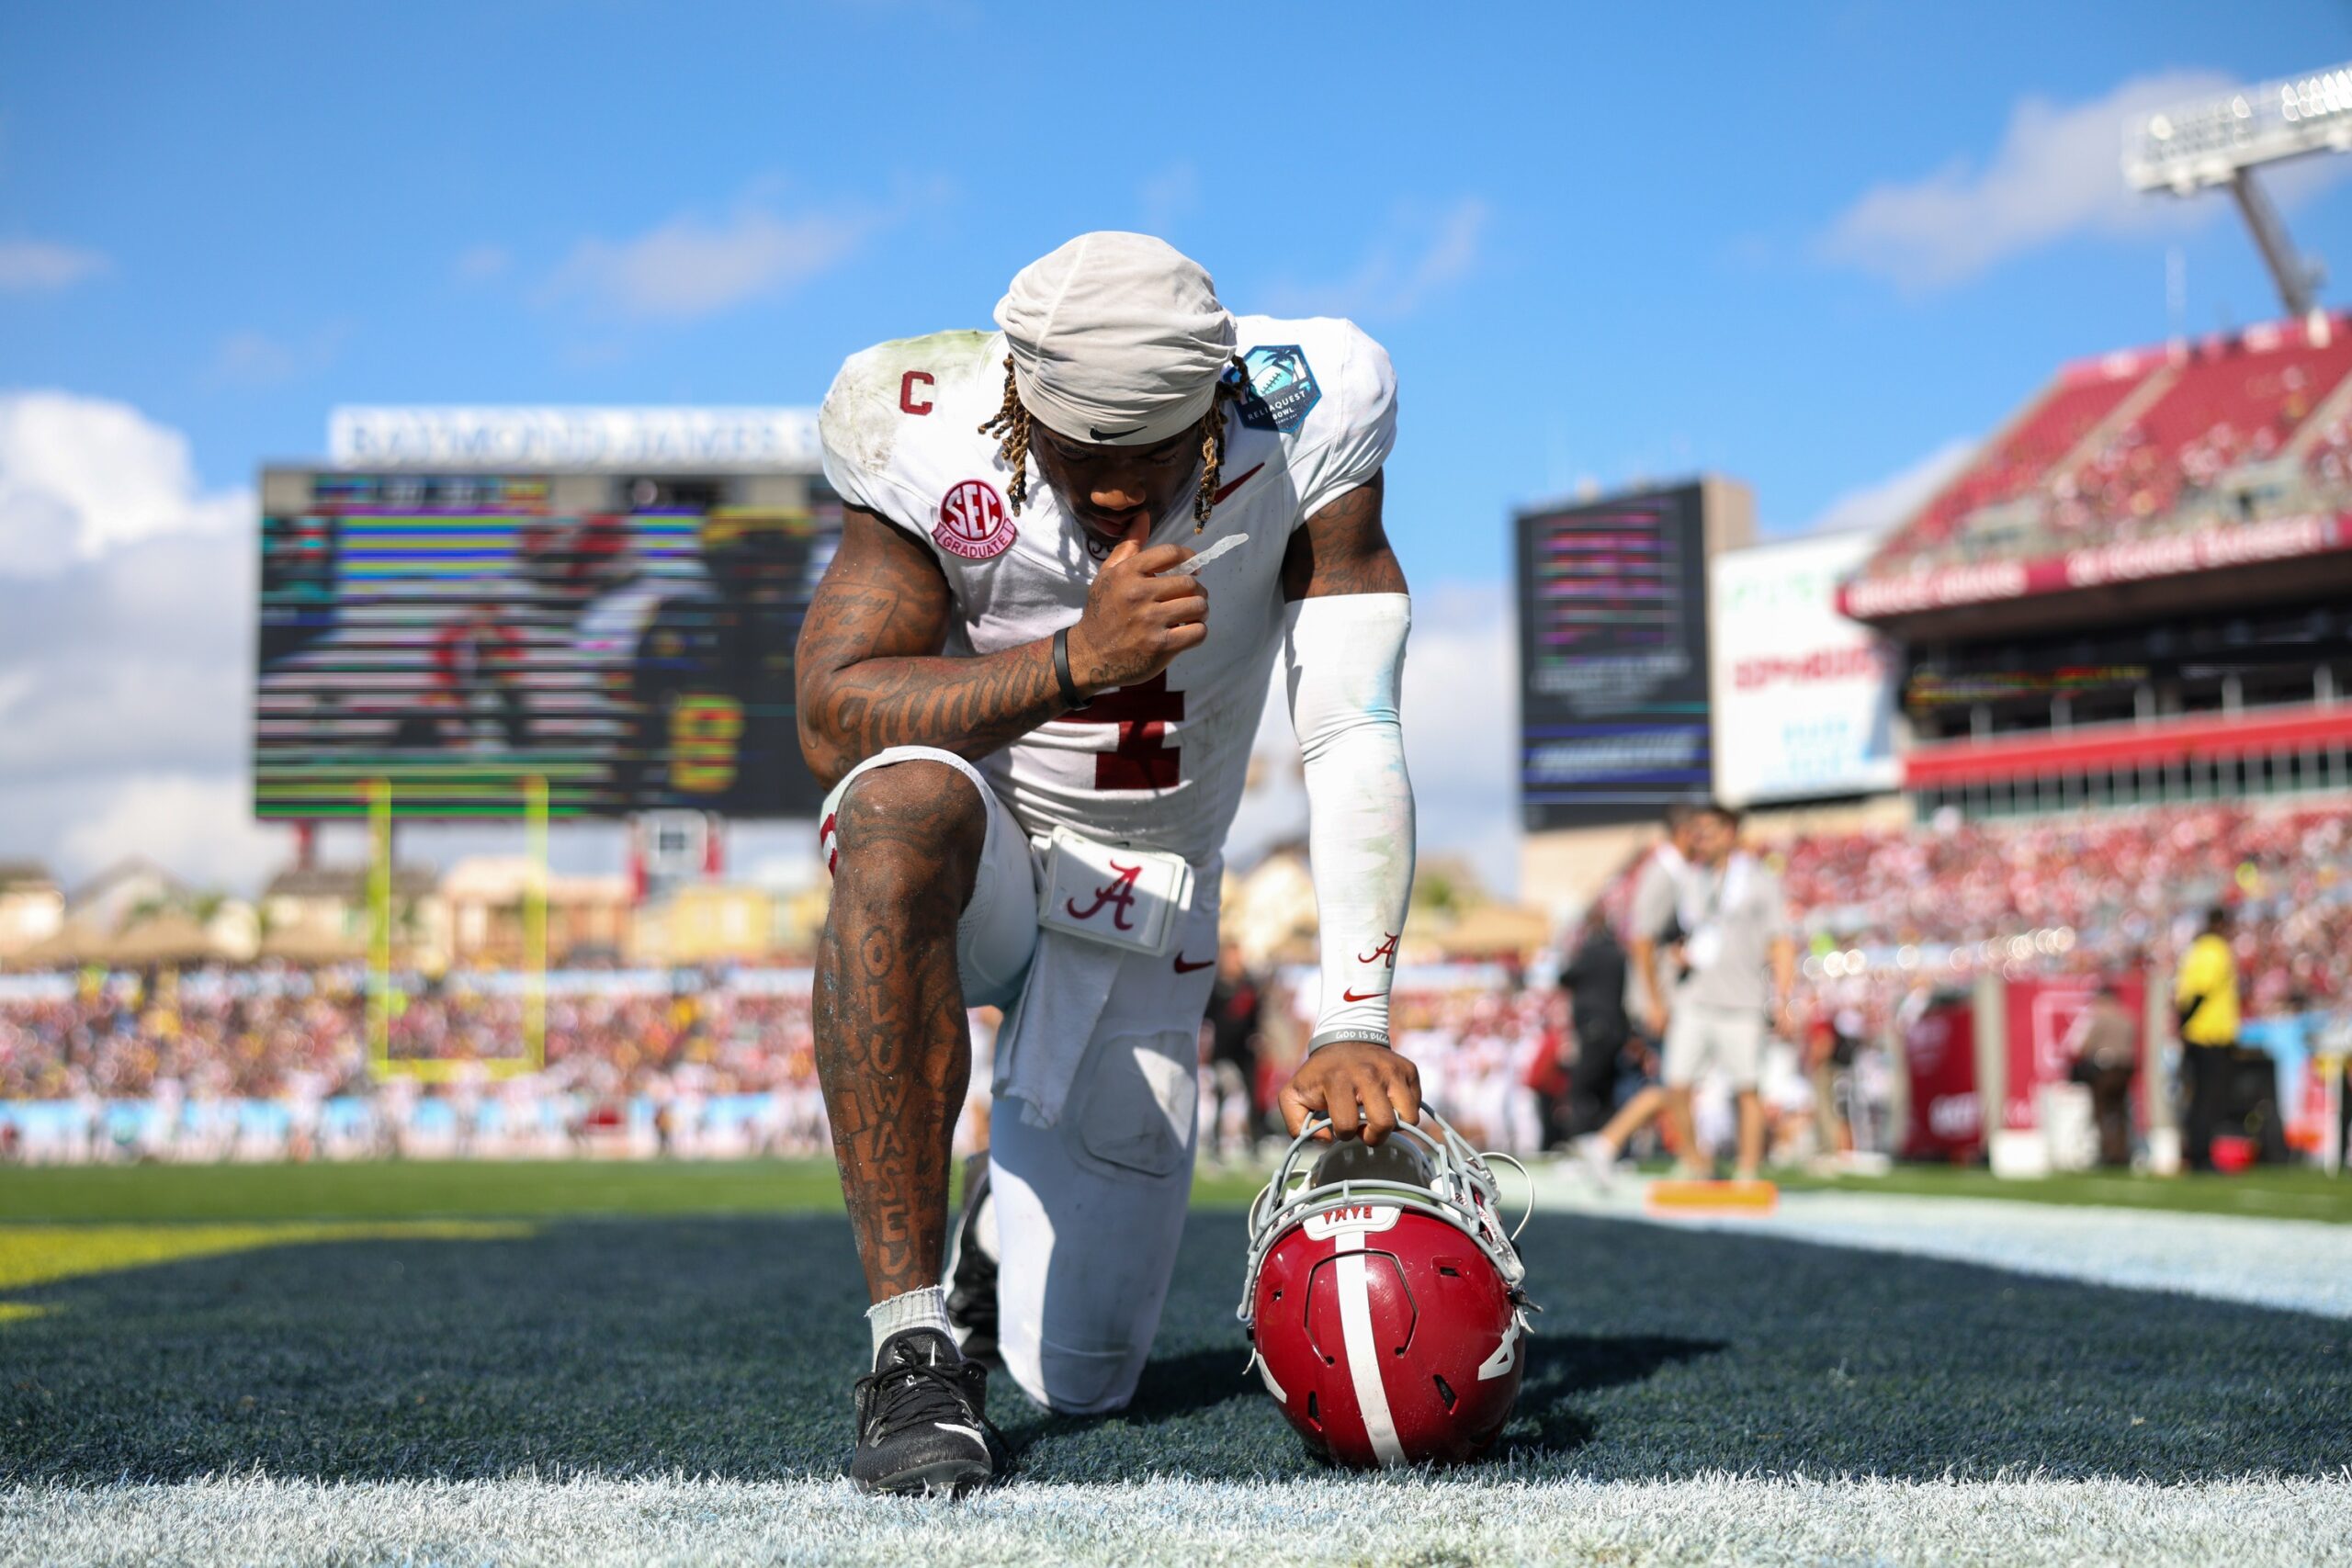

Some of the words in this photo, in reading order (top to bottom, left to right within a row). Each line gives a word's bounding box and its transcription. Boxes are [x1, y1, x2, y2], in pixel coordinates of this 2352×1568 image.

[899, 370, 934, 416] C
[1248, 390, 1306, 420] RELIAQUEST
[1272, 406, 1295, 420] BOWL
[945, 484, 1000, 539] SEC
[943, 534, 1009, 558] GRADUATE
[1336, 1030, 1356, 1039] GOD
[1359, 1030, 1368, 1039] IS
[1323, 1204, 1373, 1224] BAMA
